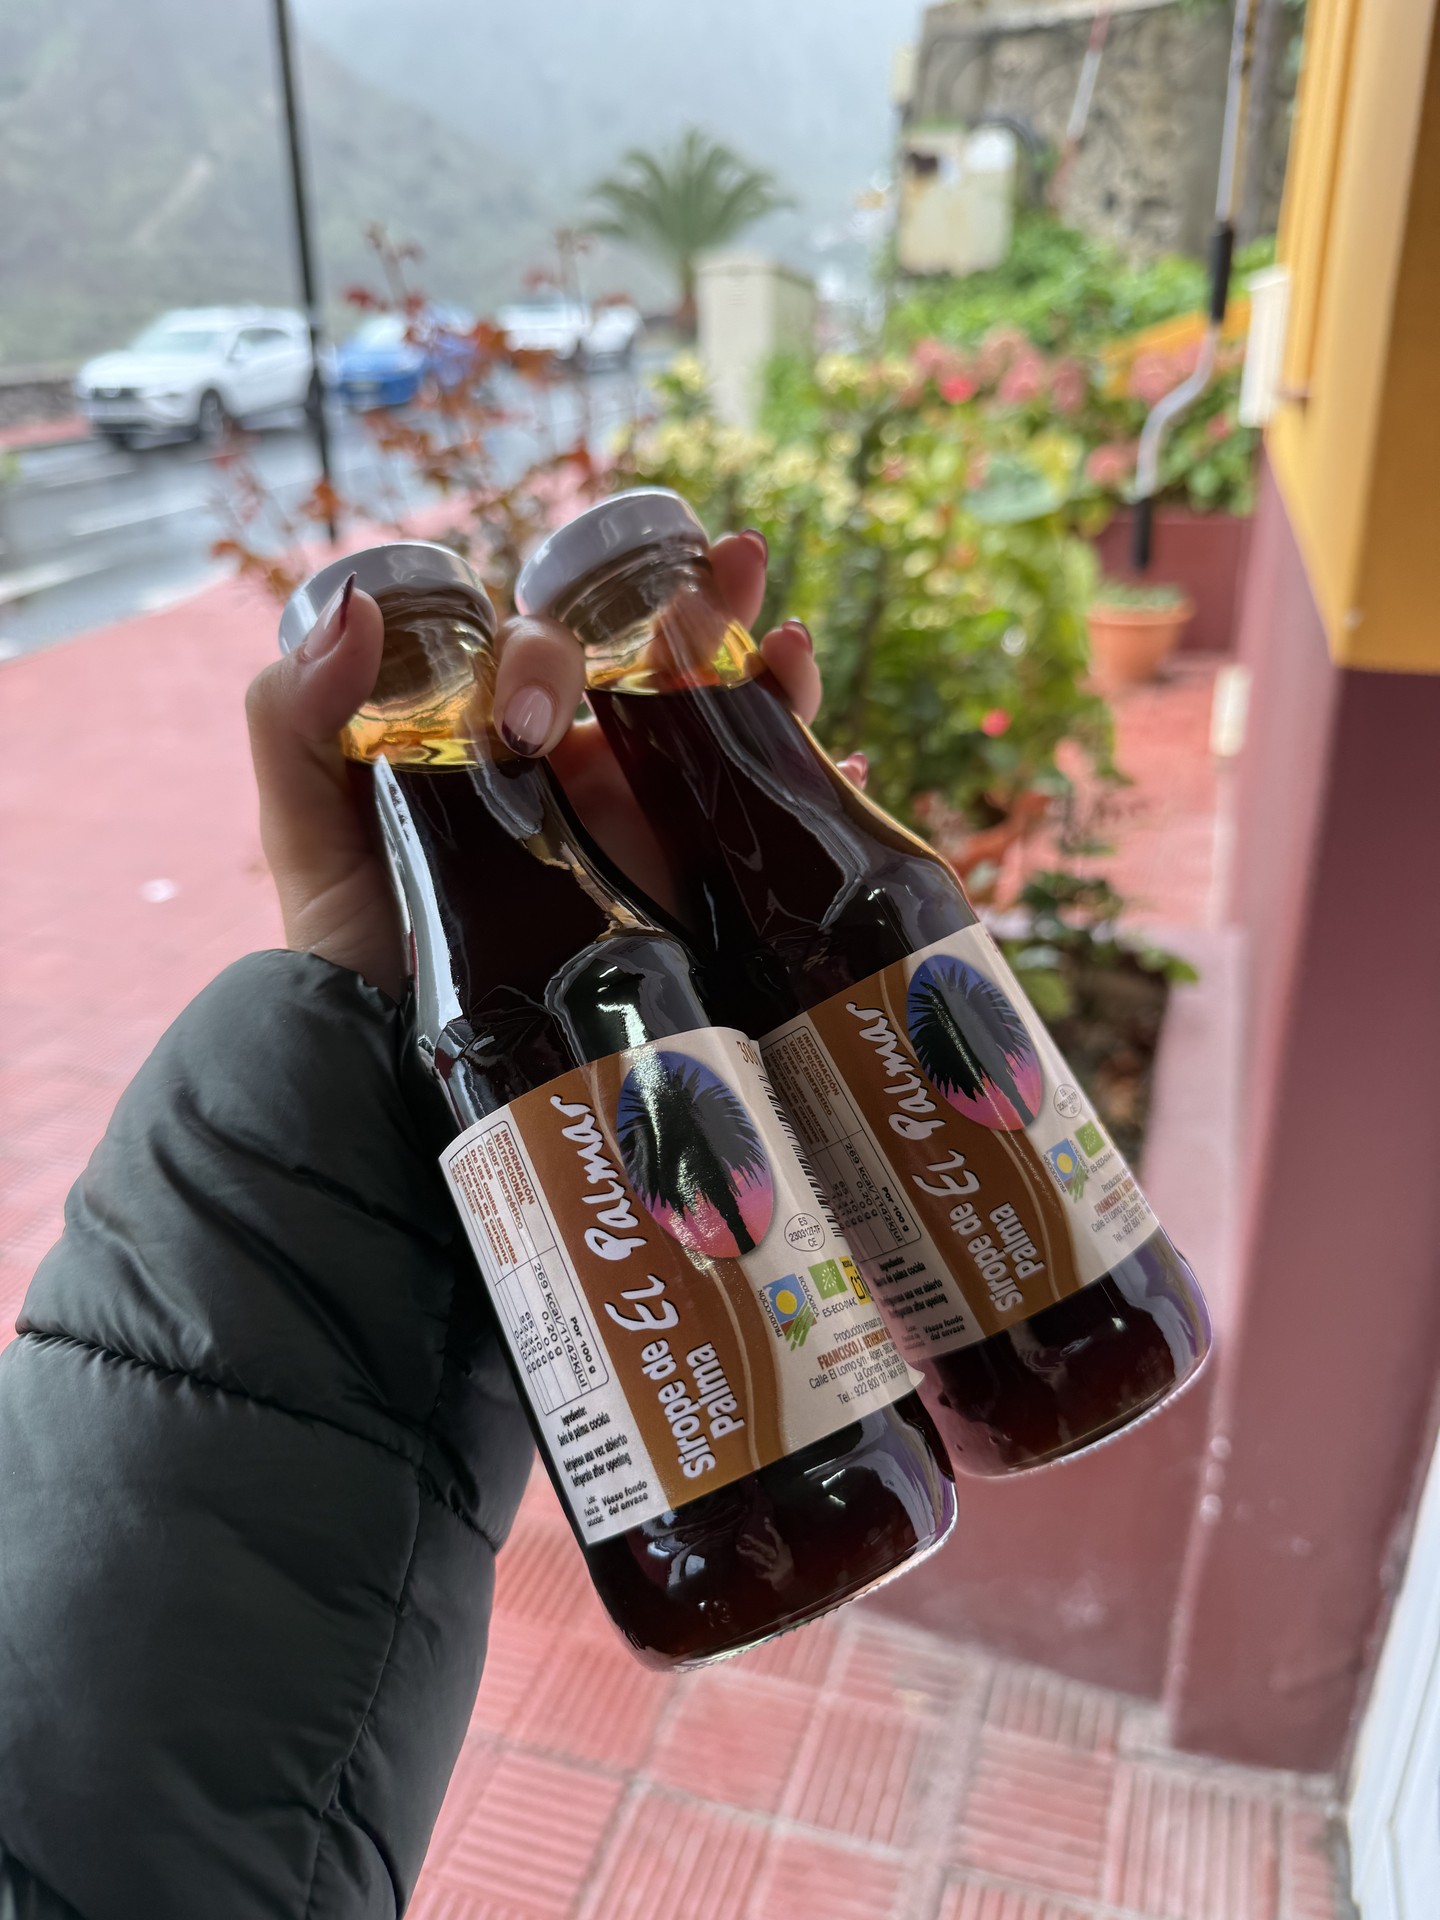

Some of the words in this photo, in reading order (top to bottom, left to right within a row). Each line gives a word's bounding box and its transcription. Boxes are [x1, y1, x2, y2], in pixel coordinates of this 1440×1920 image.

[782, 1045, 800, 1074] Grasas
[789, 1041, 804, 1064] Valor
[797, 1037, 830, 1096] NUTRICIONAL
[802, 1033, 839, 1095] INFORMACIÓN
[846, 1002, 946, 1140] Palmar
[477, 1145, 493, 1180] Grasas
[494, 1134, 525, 1204] NUTRICIONAL
[501, 1130, 534, 1204] INFORMACIÓN
[845, 1143, 859, 1164] 269
[470, 1149, 478, 1163] De
[476, 1165, 485, 1180] las
[483, 1182, 498, 1215] cuales
[486, 1138, 500, 1166] Valor
[497, 1170, 523, 1229] Energético
[550, 1094, 648, 1260] Palmar
[464, 1154, 484, 1200] Hidratos
[483, 1202, 490, 1216] de
[489, 1219, 508, 1263] carbono
[798, 1216, 808, 1227] ES
[882, 1187, 894, 1203] Por
[893, 1206, 905, 1223] 100
[950, 1200, 986, 1237] de
[807, 1238, 818, 1248] CE
[990, 1202, 1045, 1279] Palma
[534, 1263, 548, 1289] 269
[907, 1262, 926, 1275] cocida
[967, 1236, 1024, 1312] Sirope
[605, 1273, 679, 1330] El
[913, 1287, 924, 1296] vez
[923, 1279, 942, 1292] abierto
[757, 1289, 783, 1338] PRODUCCIÓN
[943, 1315, 963, 1326] fondo
[543, 1337, 550, 1346] 0
[547, 1350, 554, 1360] g
[554, 1346, 562, 1356] g
[570, 1317, 582, 1337] Por
[581, 1341, 592, 1362] 100
[589, 1365, 596, 1374] g
[642, 1337, 677, 1376] de
[817, 1342, 858, 1370] FRANCISCO
[809, 1374, 829, 1389] Calle
[828, 1368, 837, 1380] El
[836, 1361, 857, 1376] Lomo
[856, 1356, 867, 1367] s/n
[854, 1371, 864, 1382] La
[854, 1382, 868, 1396] 922
[687, 1341, 746, 1440] Palma
[573, 1424, 590, 1441] palma
[589, 1413, 610, 1430] cocida
[660, 1377, 716, 1480] Sirope
[594, 1446, 605, 1457] vez
[605, 1435, 627, 1452] abierto
[592, 1464, 606, 1477] after
[606, 1453, 632, 1471] opening
[602, 1492, 624, 1506] Véase
[624, 1481, 647, 1496] fondo
[609, 1504, 619, 1515] del
[621, 1493, 648, 1510] envase
